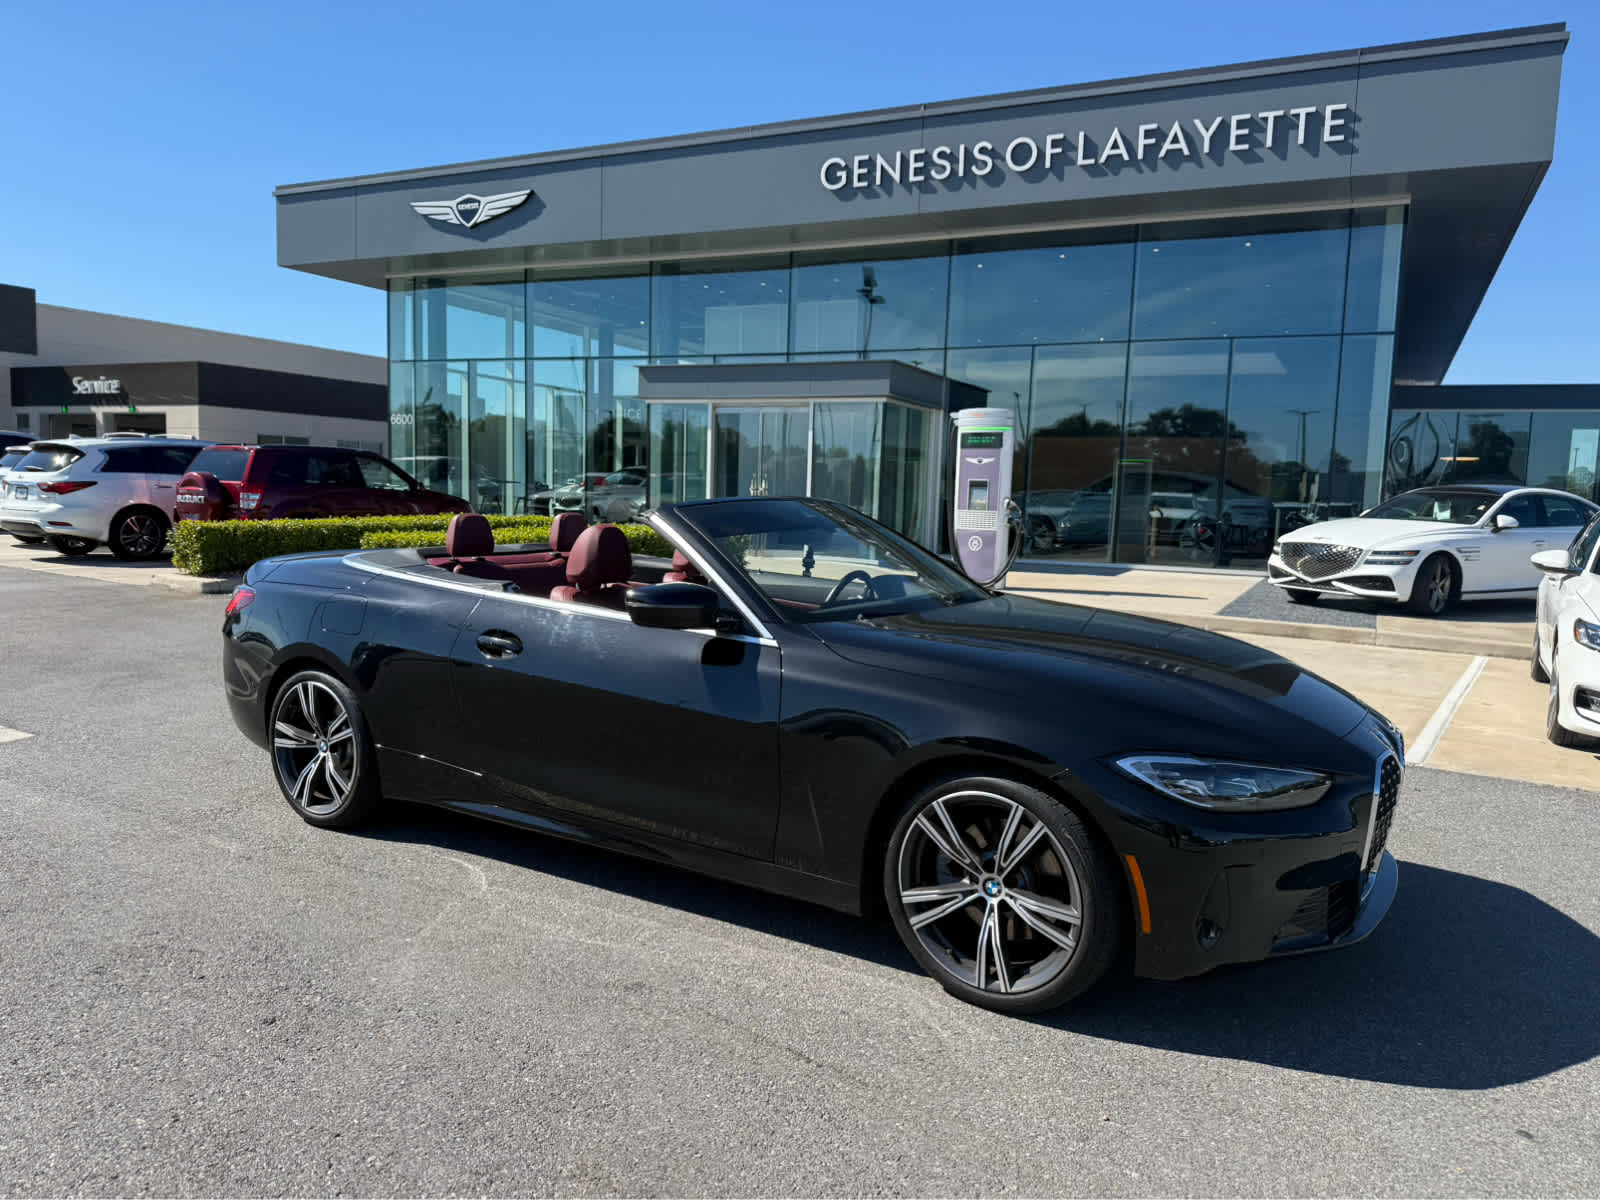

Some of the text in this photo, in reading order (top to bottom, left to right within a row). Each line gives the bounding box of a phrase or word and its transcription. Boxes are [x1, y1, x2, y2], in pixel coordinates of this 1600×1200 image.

[820, 103, 1348, 191] GENESIS OF LAFAYETTE
[72, 375, 120, 394] Service
[391, 413, 413, 425] 6600
